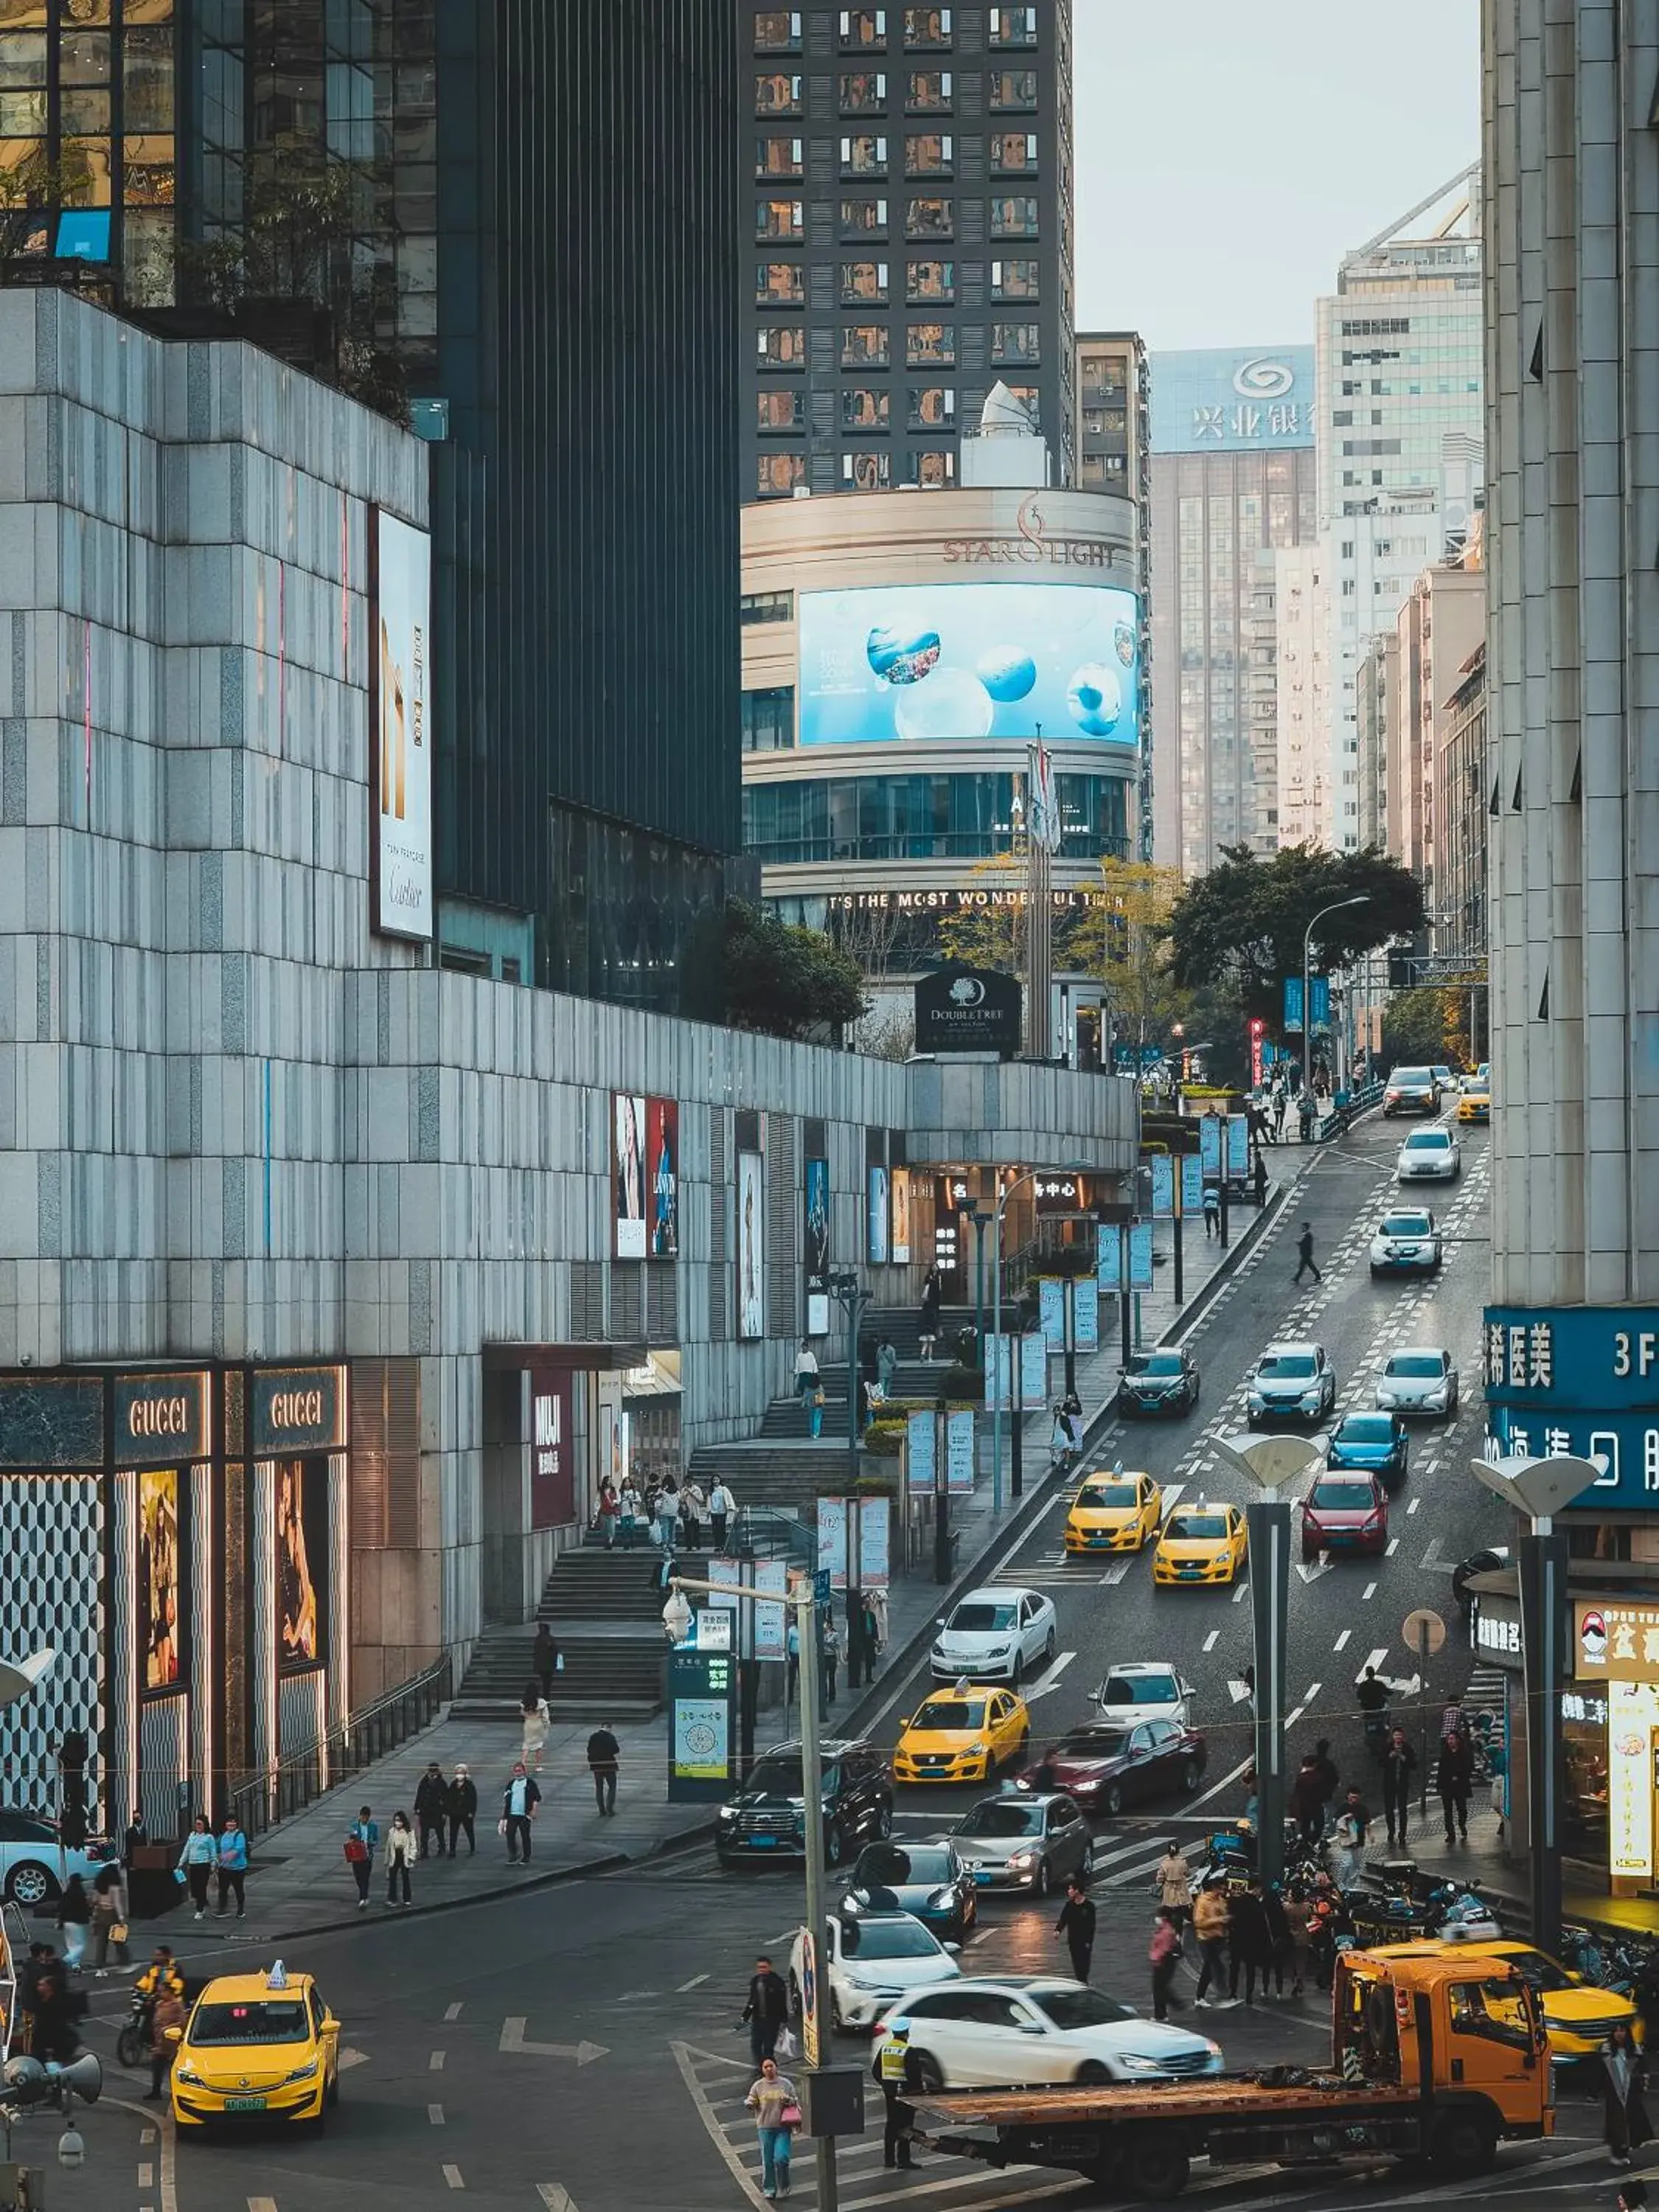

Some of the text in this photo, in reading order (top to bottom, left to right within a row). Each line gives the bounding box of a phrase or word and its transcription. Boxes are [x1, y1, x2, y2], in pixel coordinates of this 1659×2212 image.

[858, 893, 889, 908] THE
[898, 890, 950, 907] MOST
[1614, 1332, 1655, 1377] 3F
[130, 1391, 321, 1437] GUCCI GUCCI
